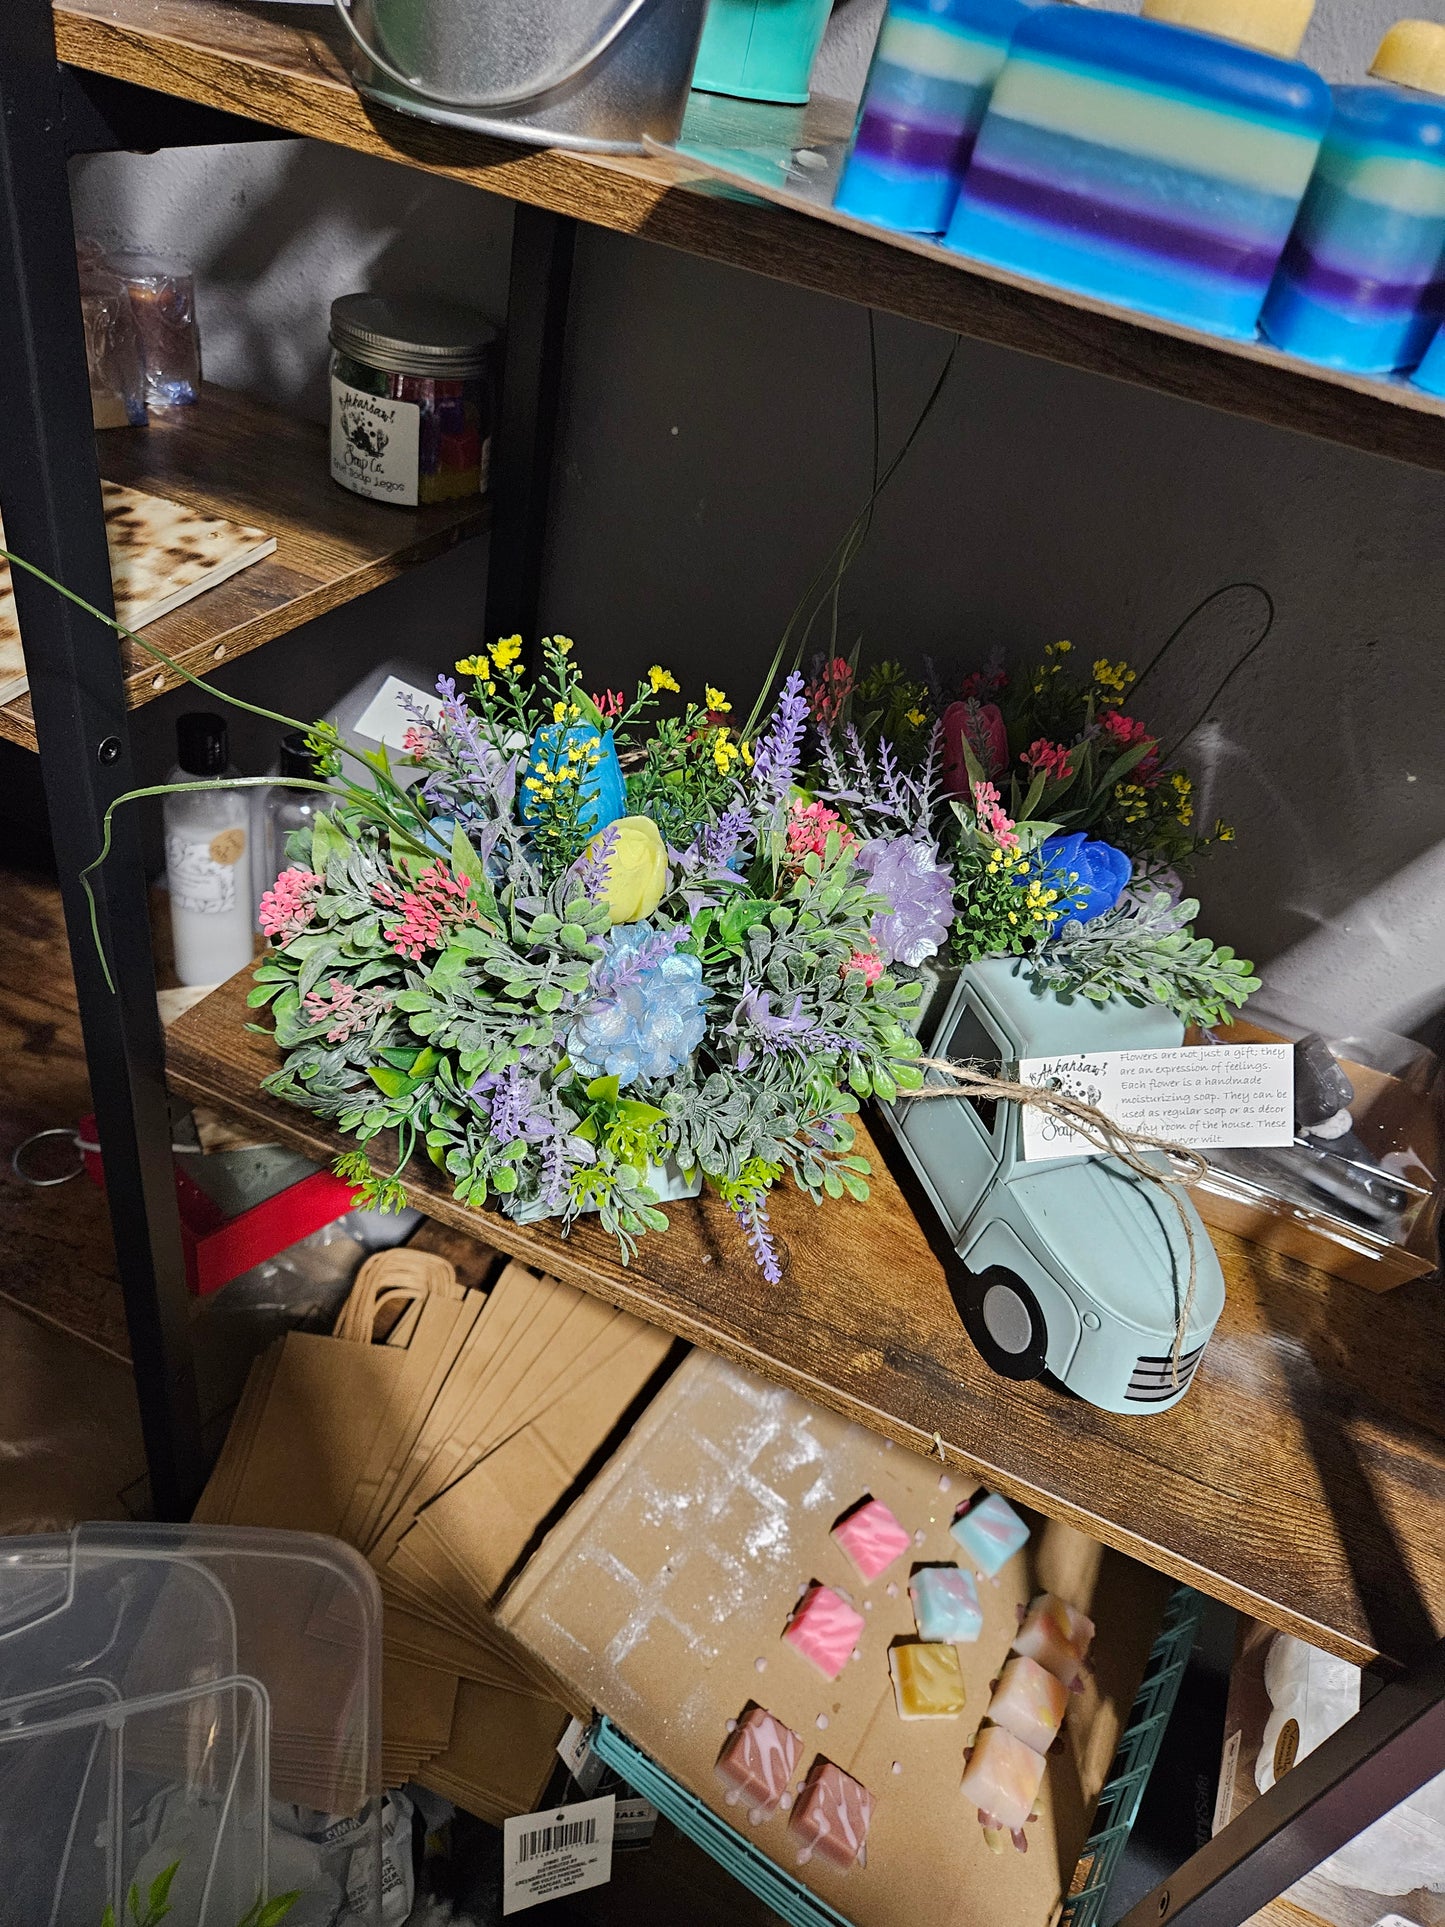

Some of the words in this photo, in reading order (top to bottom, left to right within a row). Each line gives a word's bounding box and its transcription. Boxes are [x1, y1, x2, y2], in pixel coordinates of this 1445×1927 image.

[373, 474, 405, 492] Legos
[1120, 1052, 1158, 1062] Flowers
[1161, 1051, 1177, 1059] are
[1180, 1050, 1197, 1059] not
[1197, 1047, 1221, 1062] just
[1261, 1046, 1285, 1060] they
[1120, 1067, 1136, 1076] are
[1155, 1063, 1208, 1075] expression
[1211, 1061, 1223, 1073] of
[1225, 1060, 1271, 1073] feelings.
[1121, 1080, 1146, 1089] Each
[1149, 1078, 1179, 1091] flower
[1183, 1077, 1192, 1087] is
[1205, 1076, 1262, 1086] handmade
[1121, 1092, 1191, 1104] moisturizing
[1193, 1093, 1220, 1103] soap.
[1223, 1091, 1250, 1103] They
[1253, 1091, 1273, 1099] can
[1276, 1089, 1287, 1099] be
[1121, 1109, 1145, 1118] used
[1148, 1109, 1160, 1117] as
[1163, 1107, 1202, 1119] regular
[1203, 1107, 1227, 1117] soap
[1243, 1106, 1255, 1114] as
[1258, 1104, 1286, 1114] décor
[1161, 1123, 1187, 1131] room
[1189, 1119, 1201, 1132] of
[1202, 1120, 1218, 1129] the
[1221, 1120, 1254, 1128] house.
[1256, 1119, 1286, 1128] These
[1201, 1134, 1225, 1143] wilt.
